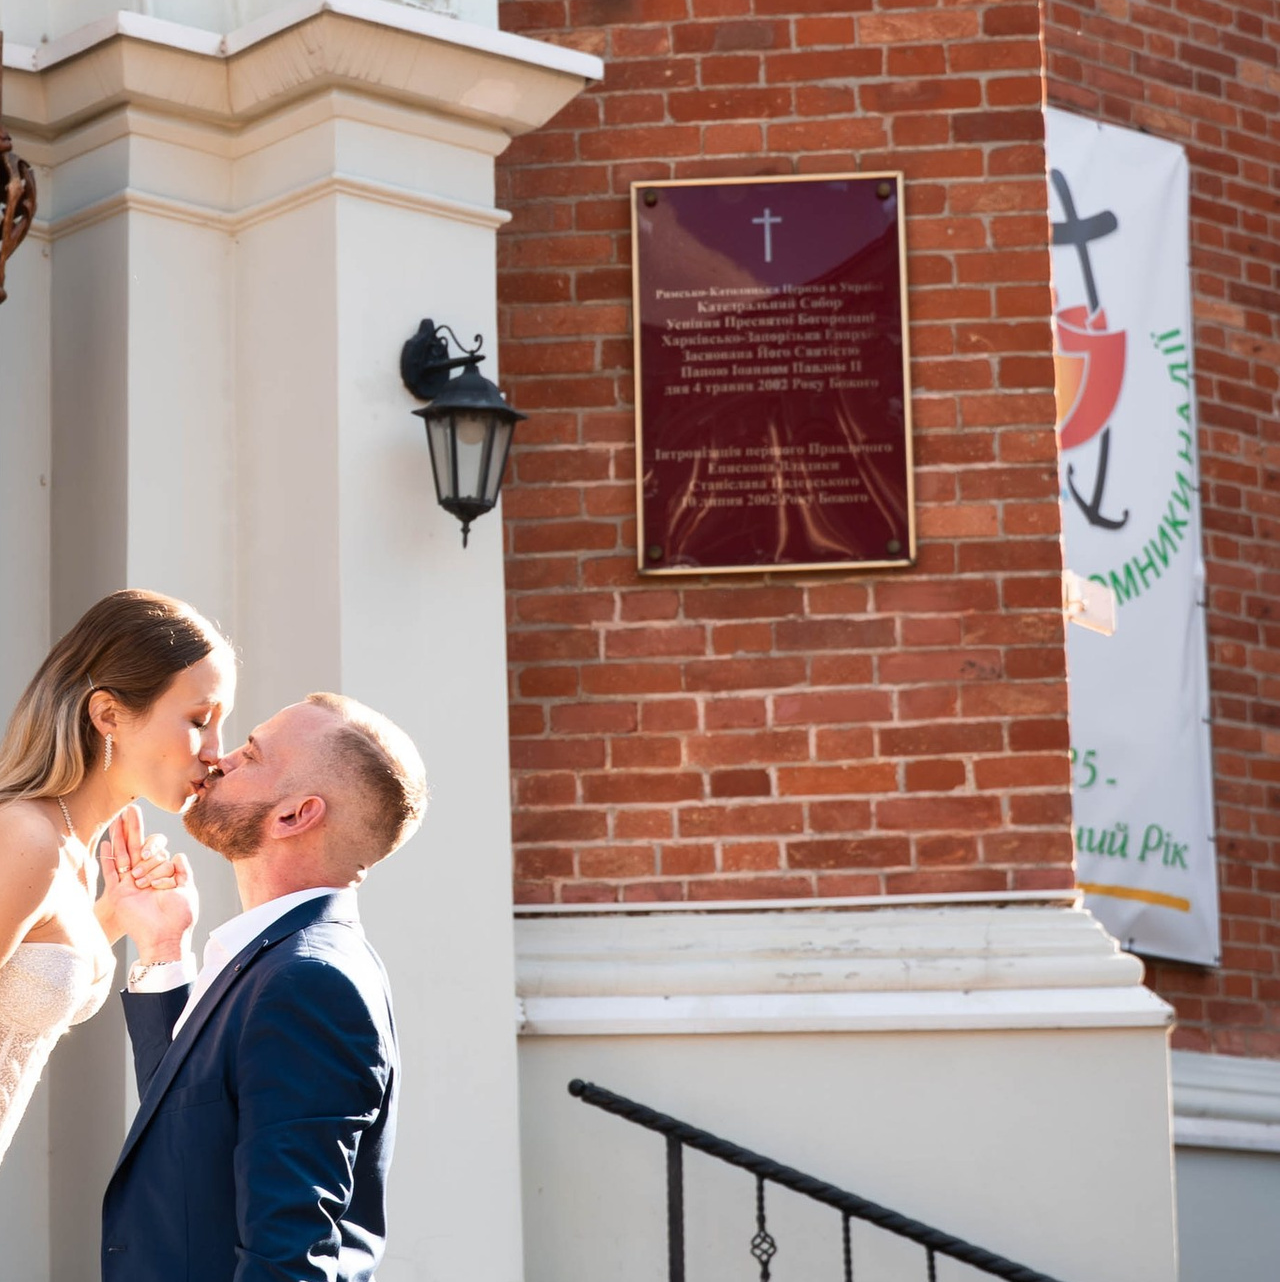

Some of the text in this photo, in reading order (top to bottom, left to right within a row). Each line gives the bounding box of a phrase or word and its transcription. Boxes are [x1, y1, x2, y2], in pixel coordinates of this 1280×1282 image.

[800, 296, 843, 311] Собор
[681, 349, 753, 362] Заснована
[757, 344, 791, 359] Його
[681, 366, 729, 379] Папою
[792, 361, 847, 374] Павлом
[664, 376, 880, 396] дня 4 травня 2002 Року Божого
[747, 493, 777, 507] 2002
[818, 490, 868, 504] Божого
[1138, 823, 1190, 870] Рік
